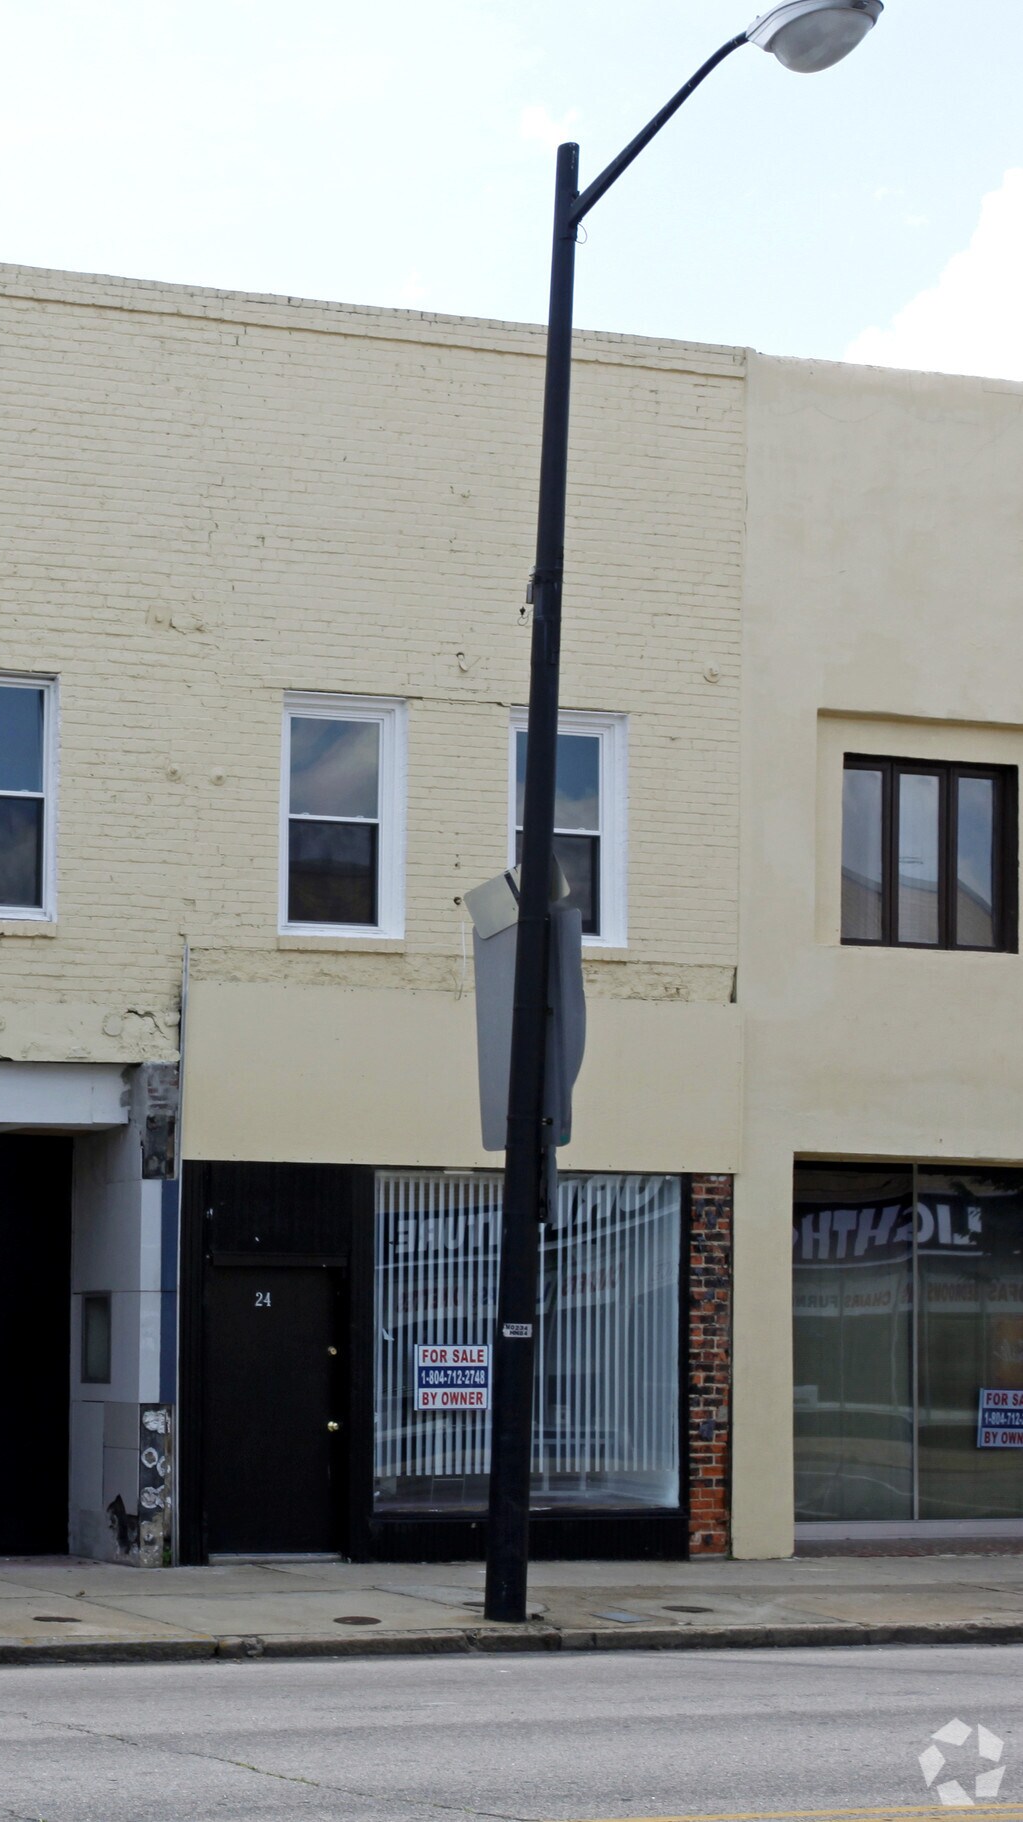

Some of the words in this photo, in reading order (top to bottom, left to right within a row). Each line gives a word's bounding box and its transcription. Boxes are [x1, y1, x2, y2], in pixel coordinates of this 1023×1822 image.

[255, 1291, 272, 1307] 24
[422, 1349, 448, 1363] FOR
[452, 1349, 484, 1363] SALE
[421, 1370, 486, 1384] 1-804-712-2748
[422, 1392, 438, 1406] BY
[441, 1391, 483, 1406] OWNER
[985, 1392, 1009, 1406] FOR
[984, 1431, 998, 1444] BY
